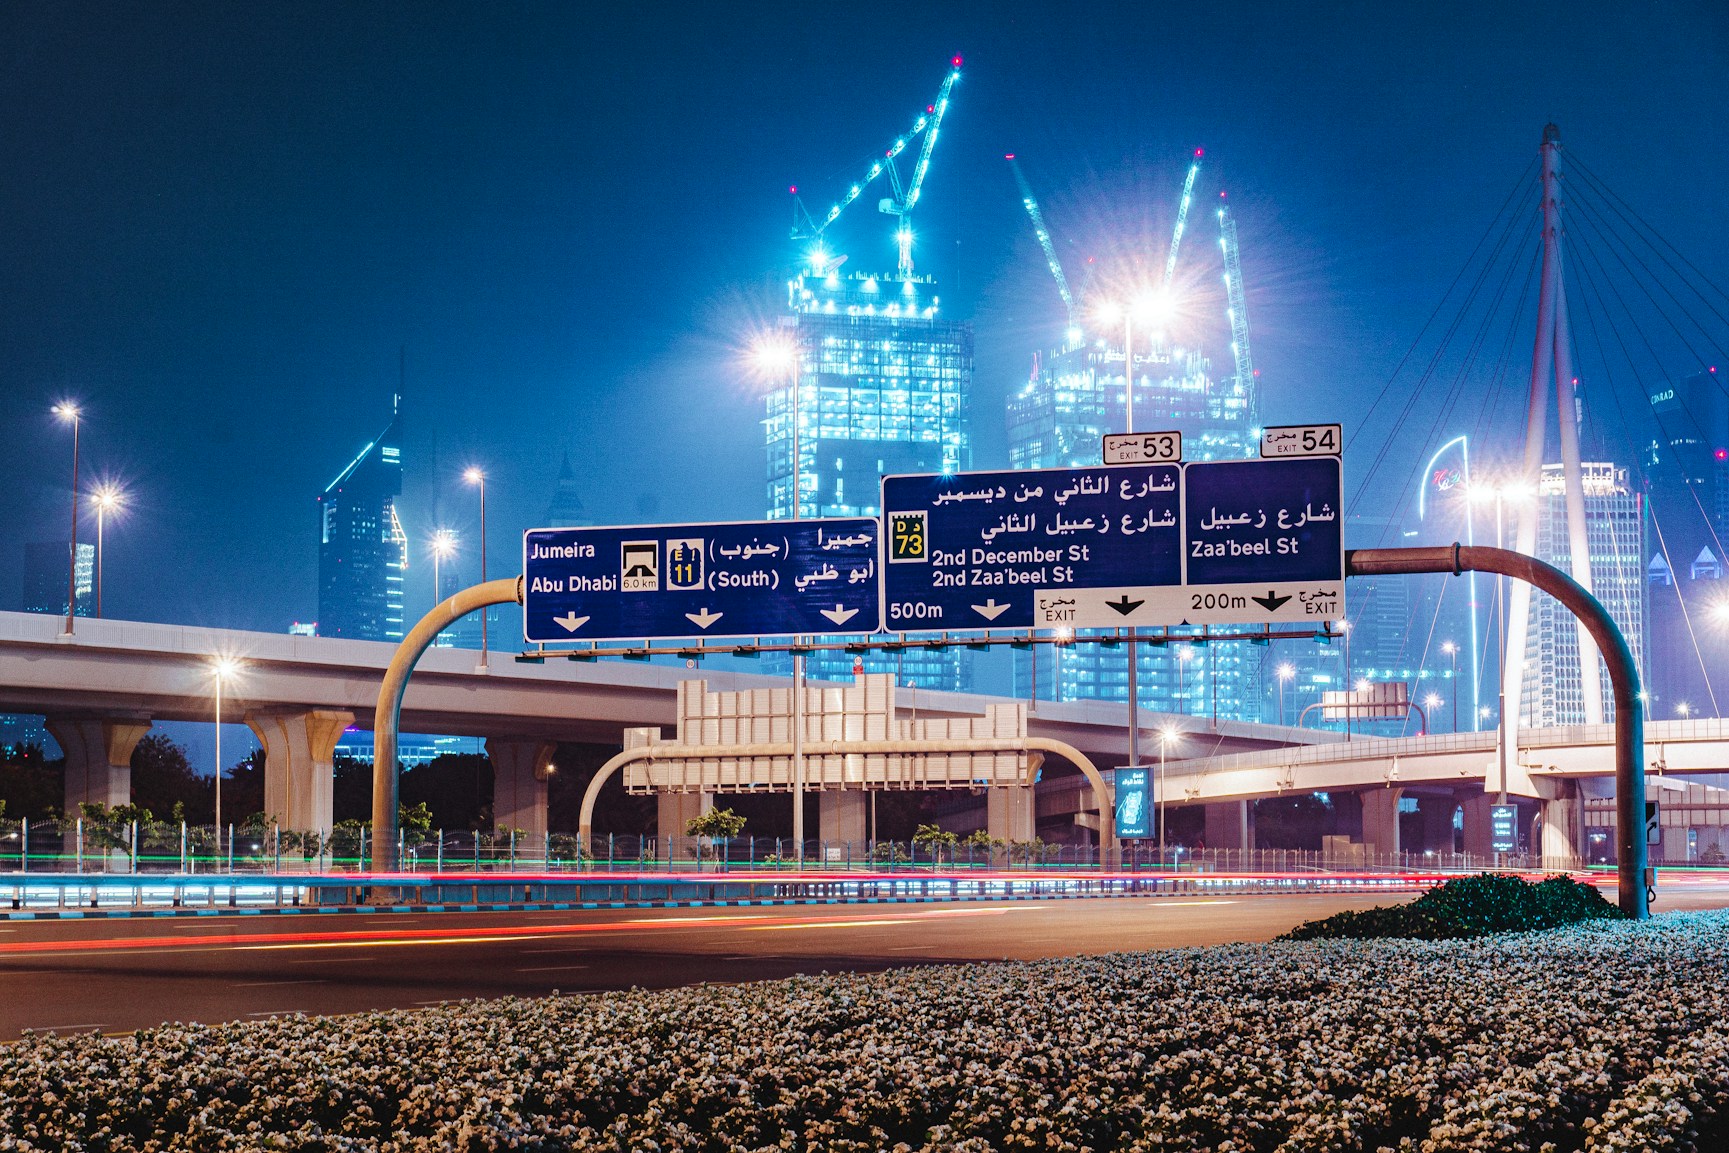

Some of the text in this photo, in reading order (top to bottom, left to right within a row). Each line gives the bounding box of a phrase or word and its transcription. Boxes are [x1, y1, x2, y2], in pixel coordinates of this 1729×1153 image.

[1109, 438, 1138, 450] مخرج
[1267, 430, 1297, 442] مخرج
[1303, 430, 1335, 451] 54
[1144, 437, 1173, 457] 53
[933, 474, 1175, 505] شارع الثاني من ديسمبر
[1201, 503, 1334, 530] شارع زعبيل
[897, 521, 906, 532] D
[982, 509, 1175, 545] شارع زعبيل الثاني
[818, 528, 872, 550] جميرا
[896, 534, 922, 554] 73
[1277, 538, 1298, 554] St
[531, 542, 594, 559] Jumeira
[933, 545, 1089, 566] 2nd December St
[675, 564, 691, 582] 11
[709, 570, 779, 591] (South)
[795, 558, 873, 592] أبو ظبي
[933, 570, 965, 586] 2nd
[1053, 566, 1073, 582] St
[531, 575, 616, 592] Abu Dhabi
[624, 579, 656, 588] 6.0 km
[1040, 597, 1076, 609] مخرج
[1192, 594, 1245, 609] 200m
[1299, 589, 1336, 601] مخرج
[891, 602, 942, 619] 500m
[1046, 610, 1075, 621] EXIT
[1306, 602, 1336, 614] EXIT
